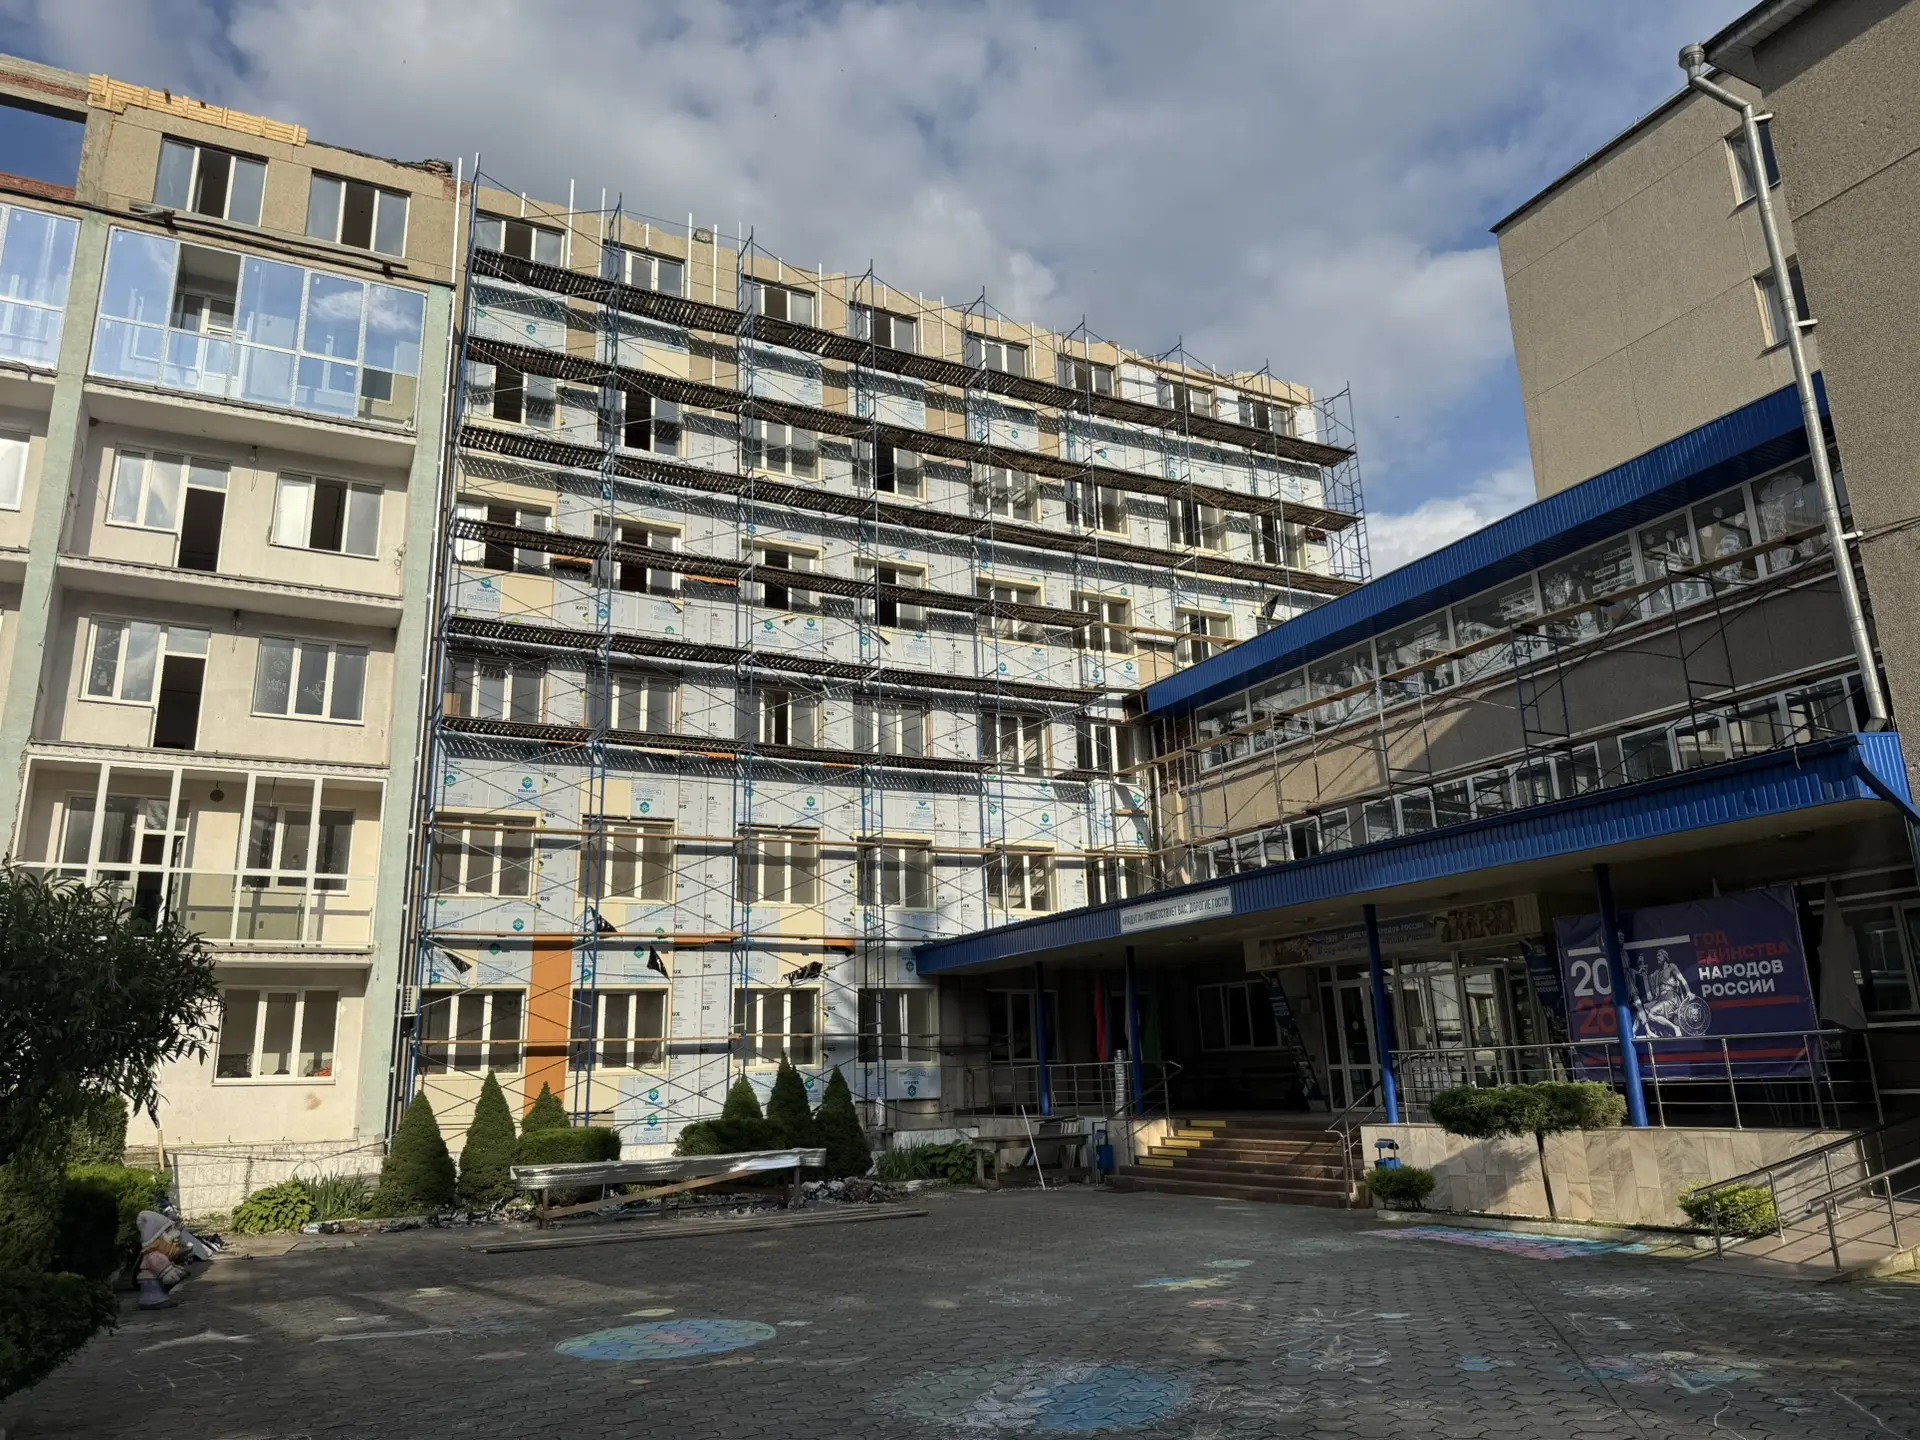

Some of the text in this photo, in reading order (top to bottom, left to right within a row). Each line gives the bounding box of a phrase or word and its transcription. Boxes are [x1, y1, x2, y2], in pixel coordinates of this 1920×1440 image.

[1144, 906, 1177, 921] ПРИВЕТСТВУЕТ
[1189, 899, 1210, 914] ДОРОГИЕ
[1692, 930, 1729, 947] ГОД
[1695, 941, 1789, 965] ЕДИНСТВА
[1570, 958, 1612, 996] 20
[1698, 960, 1784, 980] НАРОДОВ
[1701, 978, 1776, 997] РОССИИ
[1577, 996, 1618, 1033] 26
